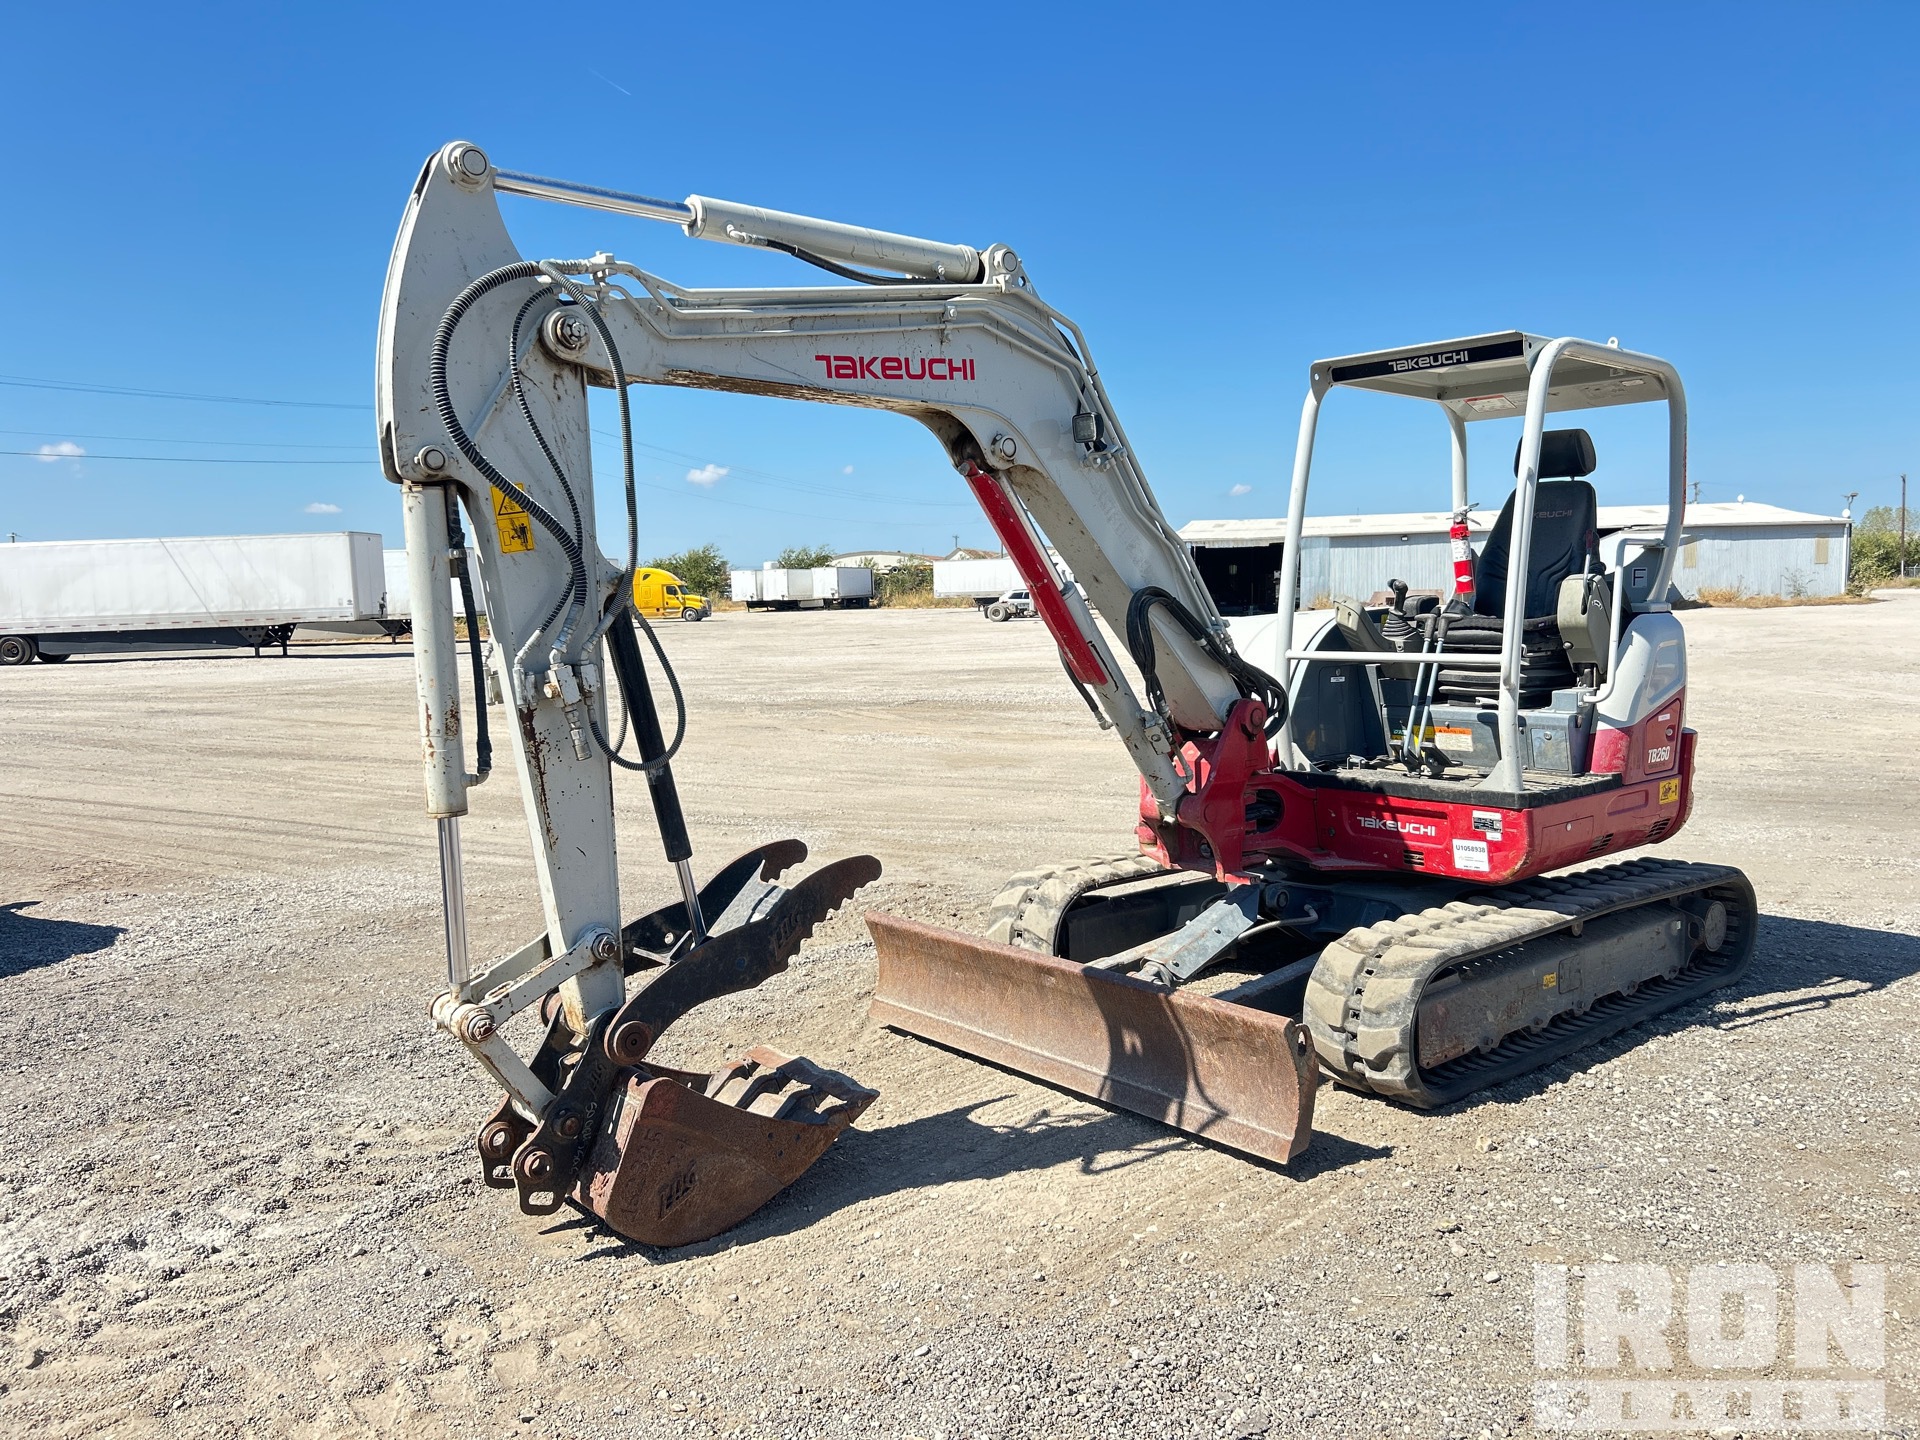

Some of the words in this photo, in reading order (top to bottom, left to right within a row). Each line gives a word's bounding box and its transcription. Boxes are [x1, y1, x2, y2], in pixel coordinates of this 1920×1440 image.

[815, 355, 975, 380] TAKEUCHI
[1388, 350, 1468, 372] TAKEUCHI
[1533, 509, 1572, 519] KEUCHI
[1633, 568, 1646, 586] F
[1648, 746, 1670, 764] TB260
[1356, 816, 1436, 837] TAKEUCHI
